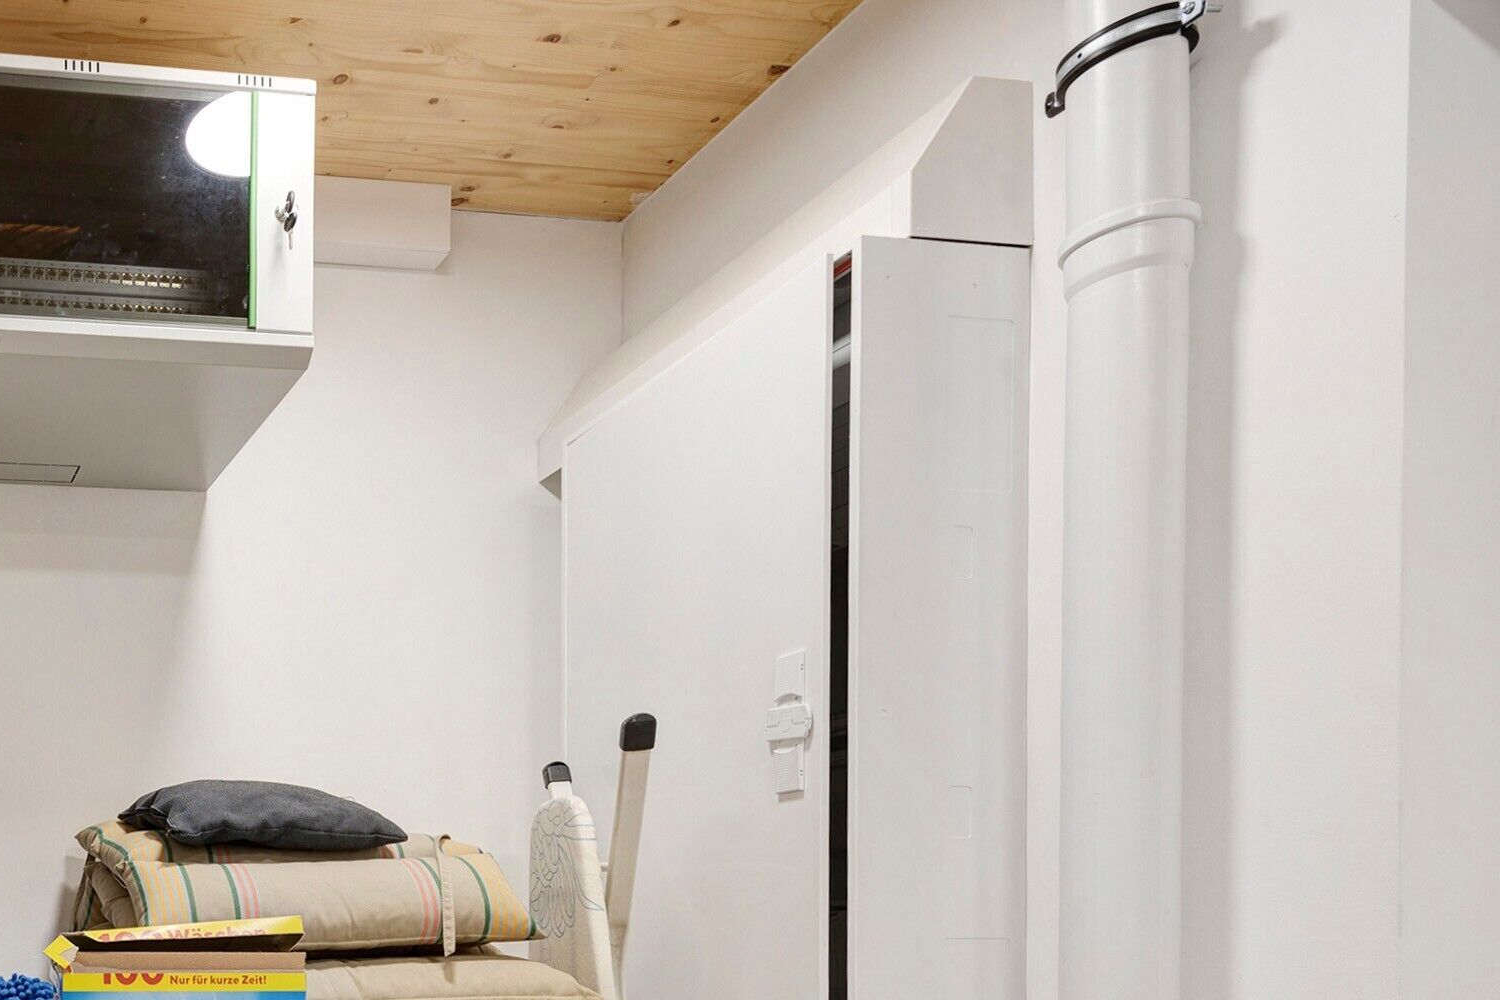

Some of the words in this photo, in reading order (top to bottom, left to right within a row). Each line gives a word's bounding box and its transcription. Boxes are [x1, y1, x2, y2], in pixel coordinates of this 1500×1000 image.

[170, 975, 189, 985] Nur
[191, 974, 209, 985] für
[210, 974, 240, 985] kurze
[241, 974, 267, 985] Zeit!
